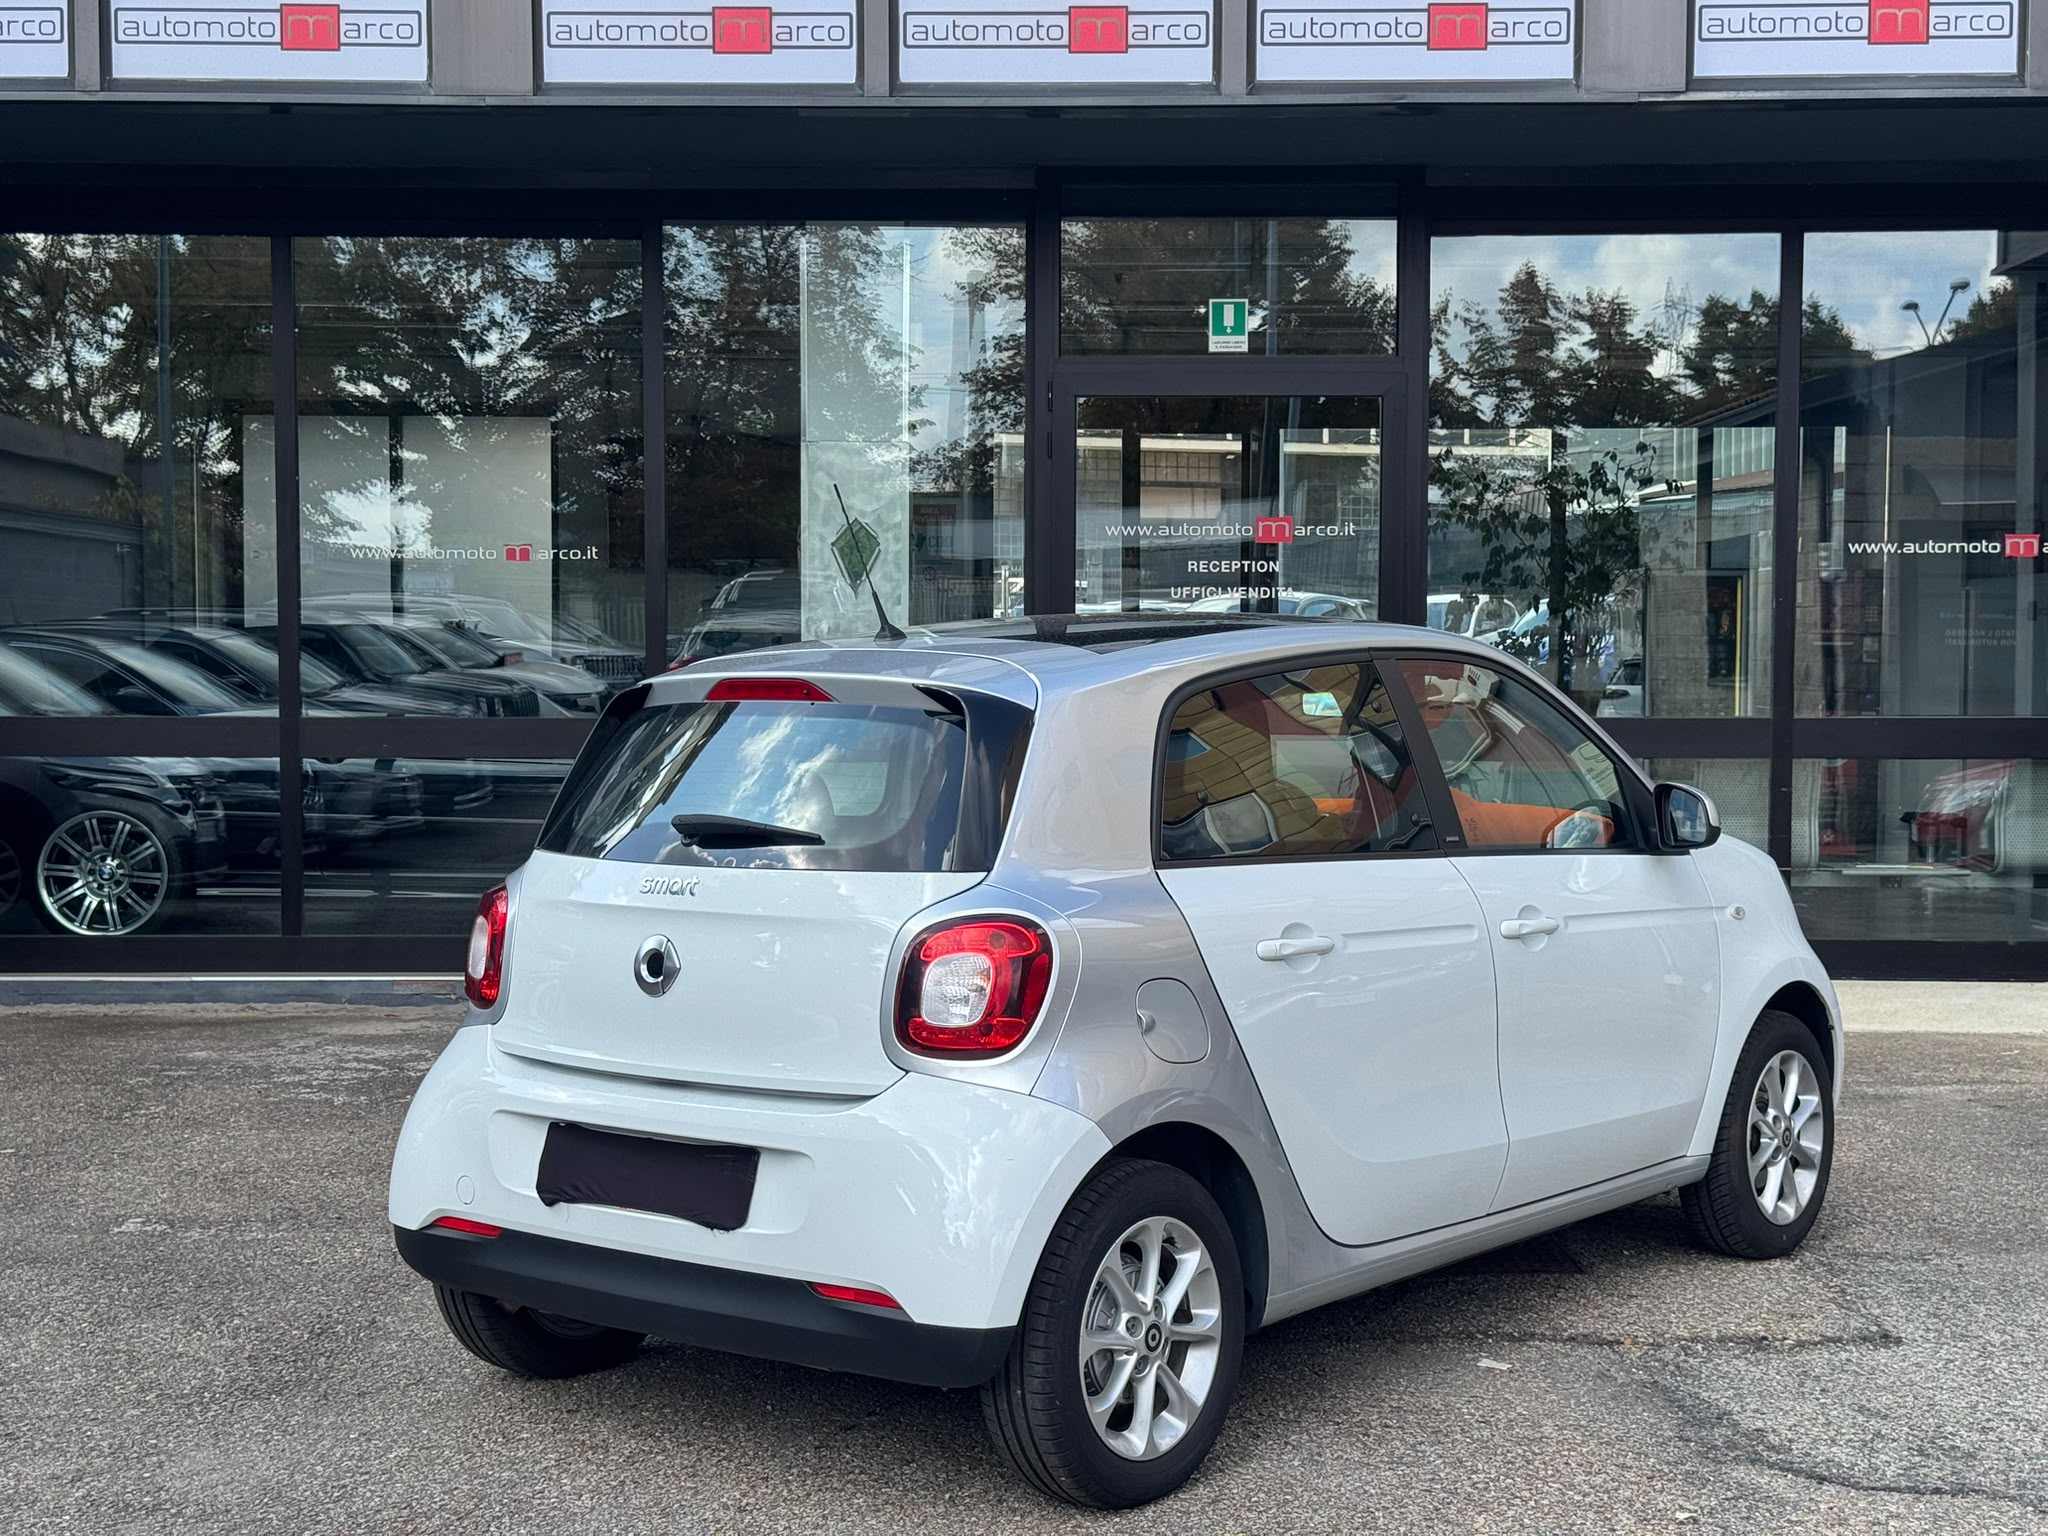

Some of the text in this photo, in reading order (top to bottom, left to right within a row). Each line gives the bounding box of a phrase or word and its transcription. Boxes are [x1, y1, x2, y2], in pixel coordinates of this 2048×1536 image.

[0, 19, 56, 36] rco
[1187, 560, 1280, 573] RECEPTION
[1170, 586, 1295, 599] UFFICI VENDITA
[639, 875, 701, 897] smart
